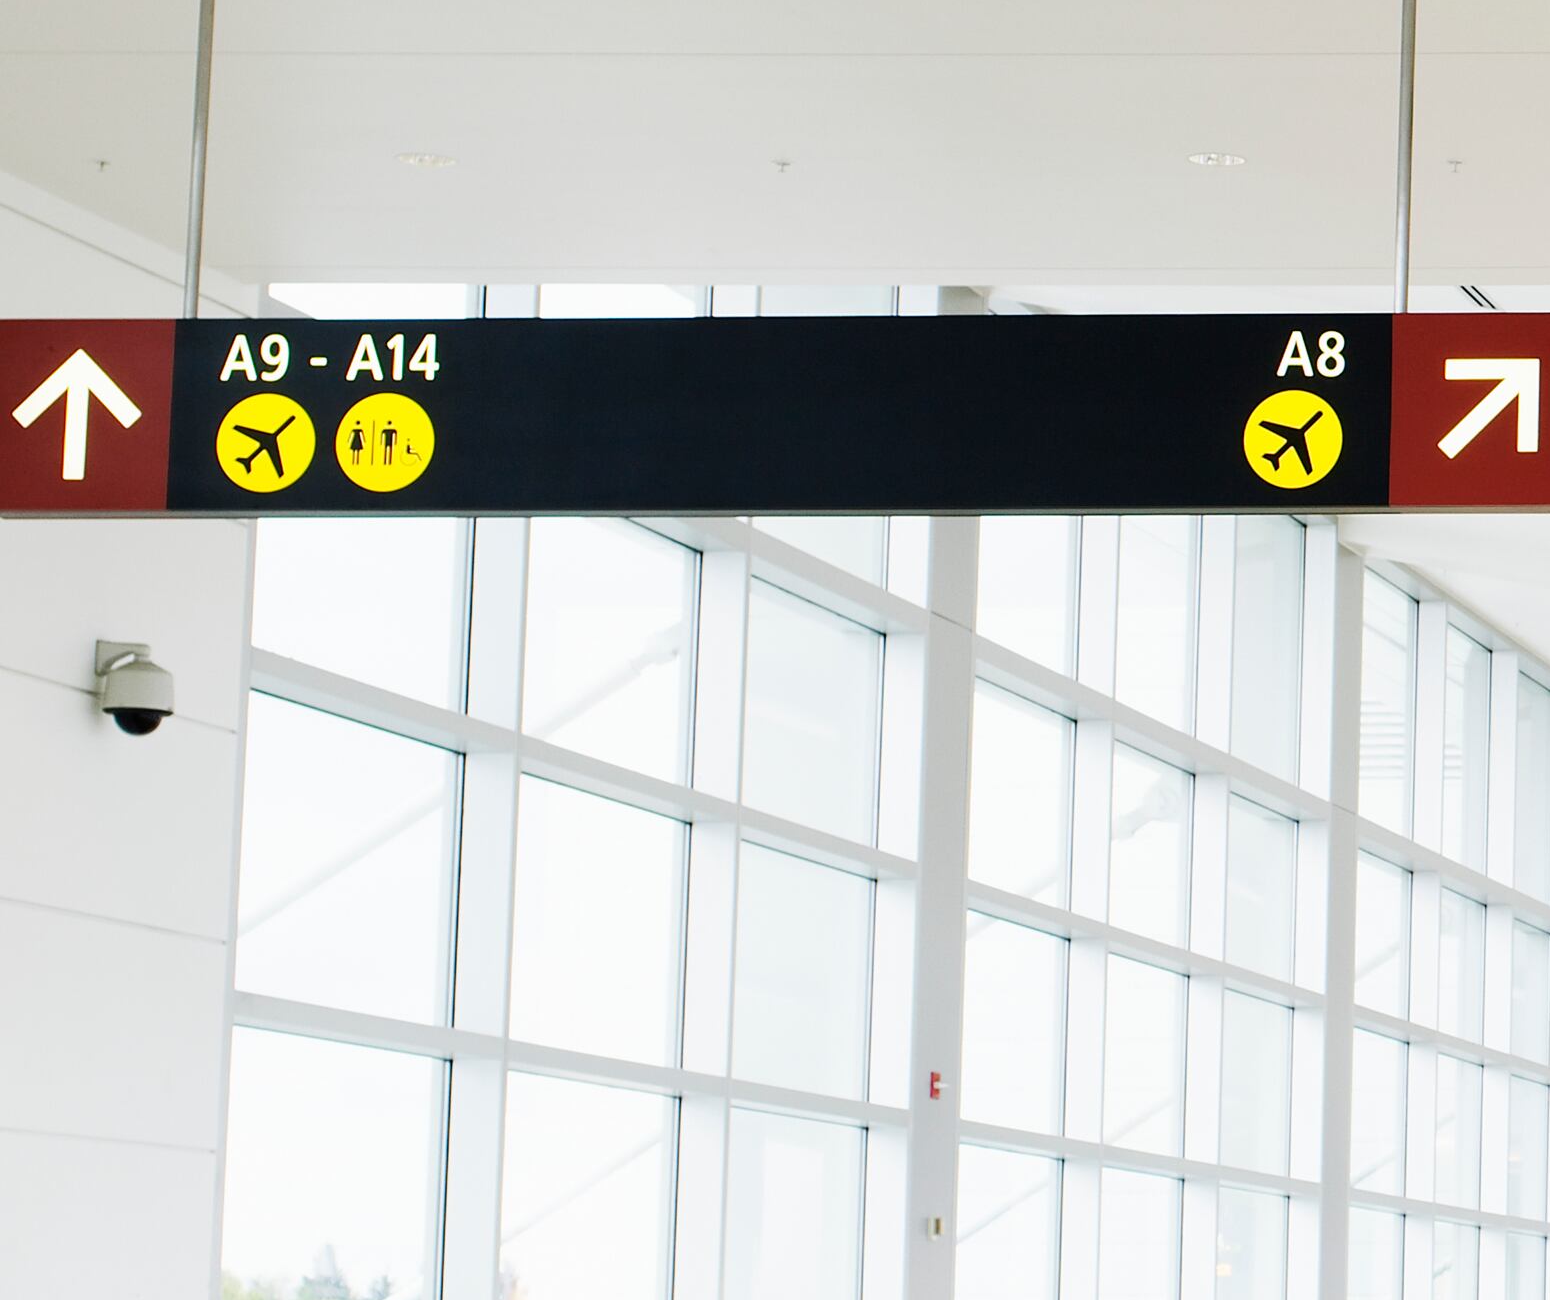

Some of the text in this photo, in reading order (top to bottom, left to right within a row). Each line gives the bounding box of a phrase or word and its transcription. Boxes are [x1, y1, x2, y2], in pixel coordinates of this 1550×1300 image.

[219, 333, 441, 382] A9 - A14
[1276, 330, 1346, 378] A8
